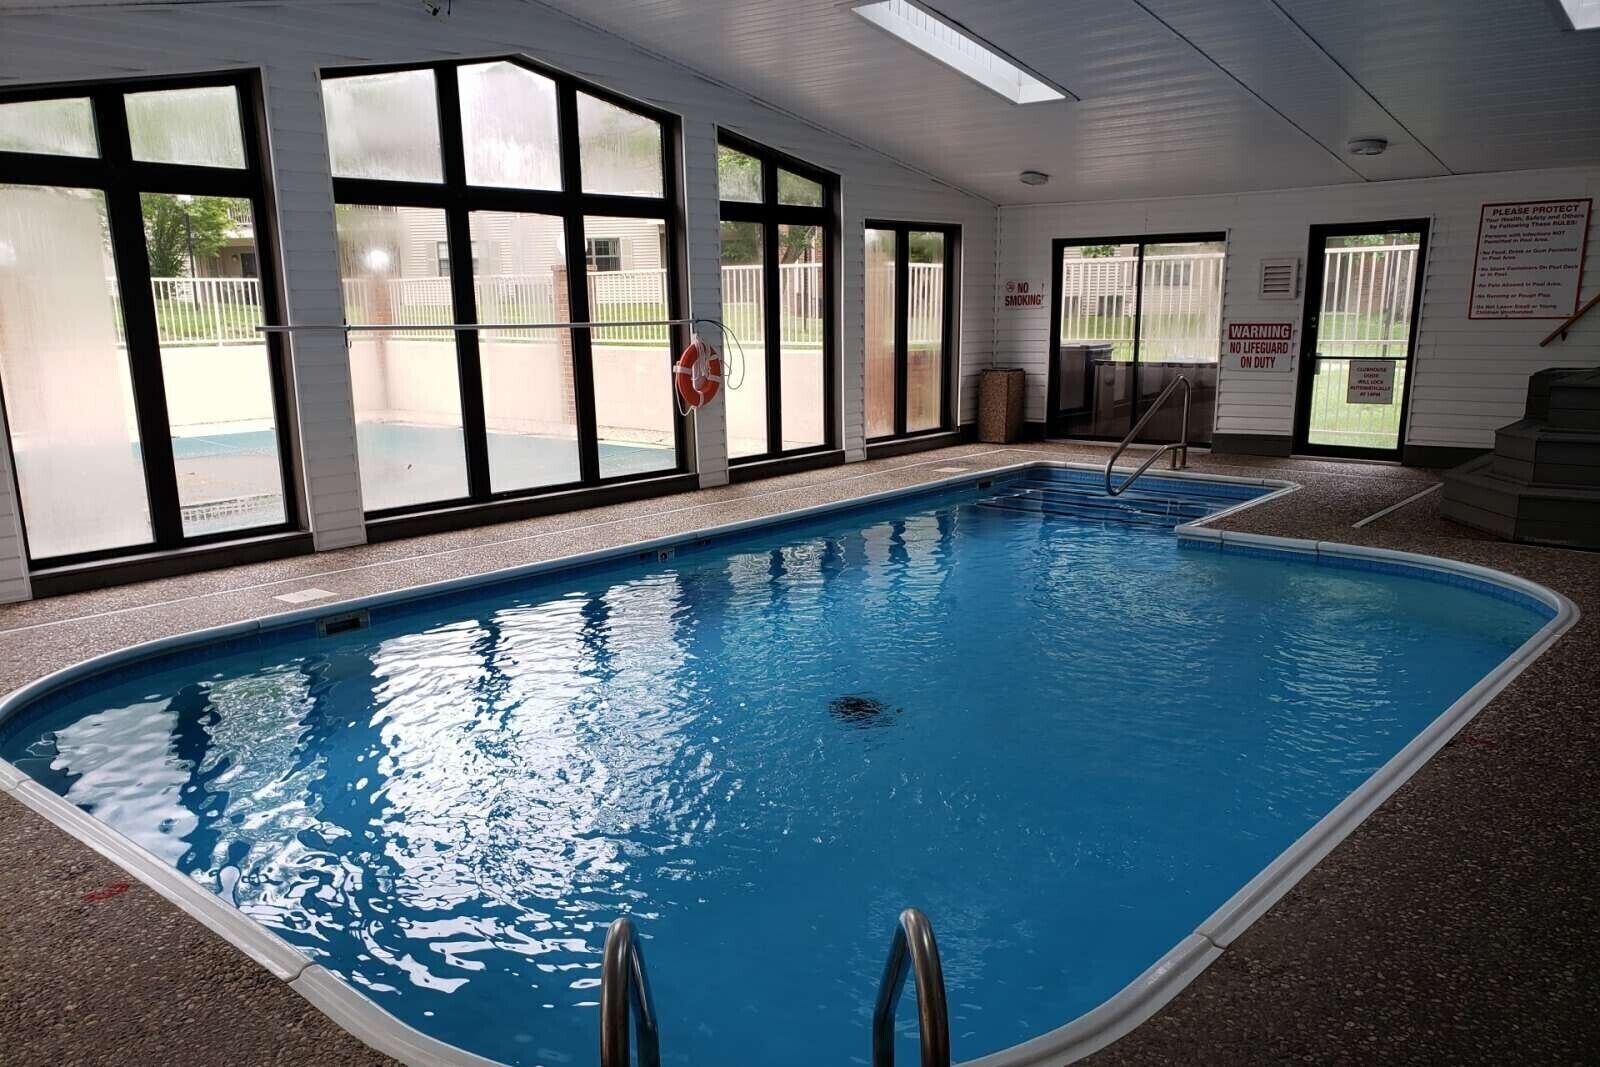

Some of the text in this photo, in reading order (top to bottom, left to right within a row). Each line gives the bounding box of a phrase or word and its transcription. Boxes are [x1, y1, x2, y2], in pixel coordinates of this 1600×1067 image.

[1492, 204, 1579, 216] PLEASE PROTECT
[1018, 282, 1029, 293] NO
[1005, 294, 1041, 306] SMOKING
[1232, 325, 1290, 338] WARNING
[1230, 342, 1288, 354] NO LIFEGUARD
[1241, 356, 1276, 368] ON DUTY
